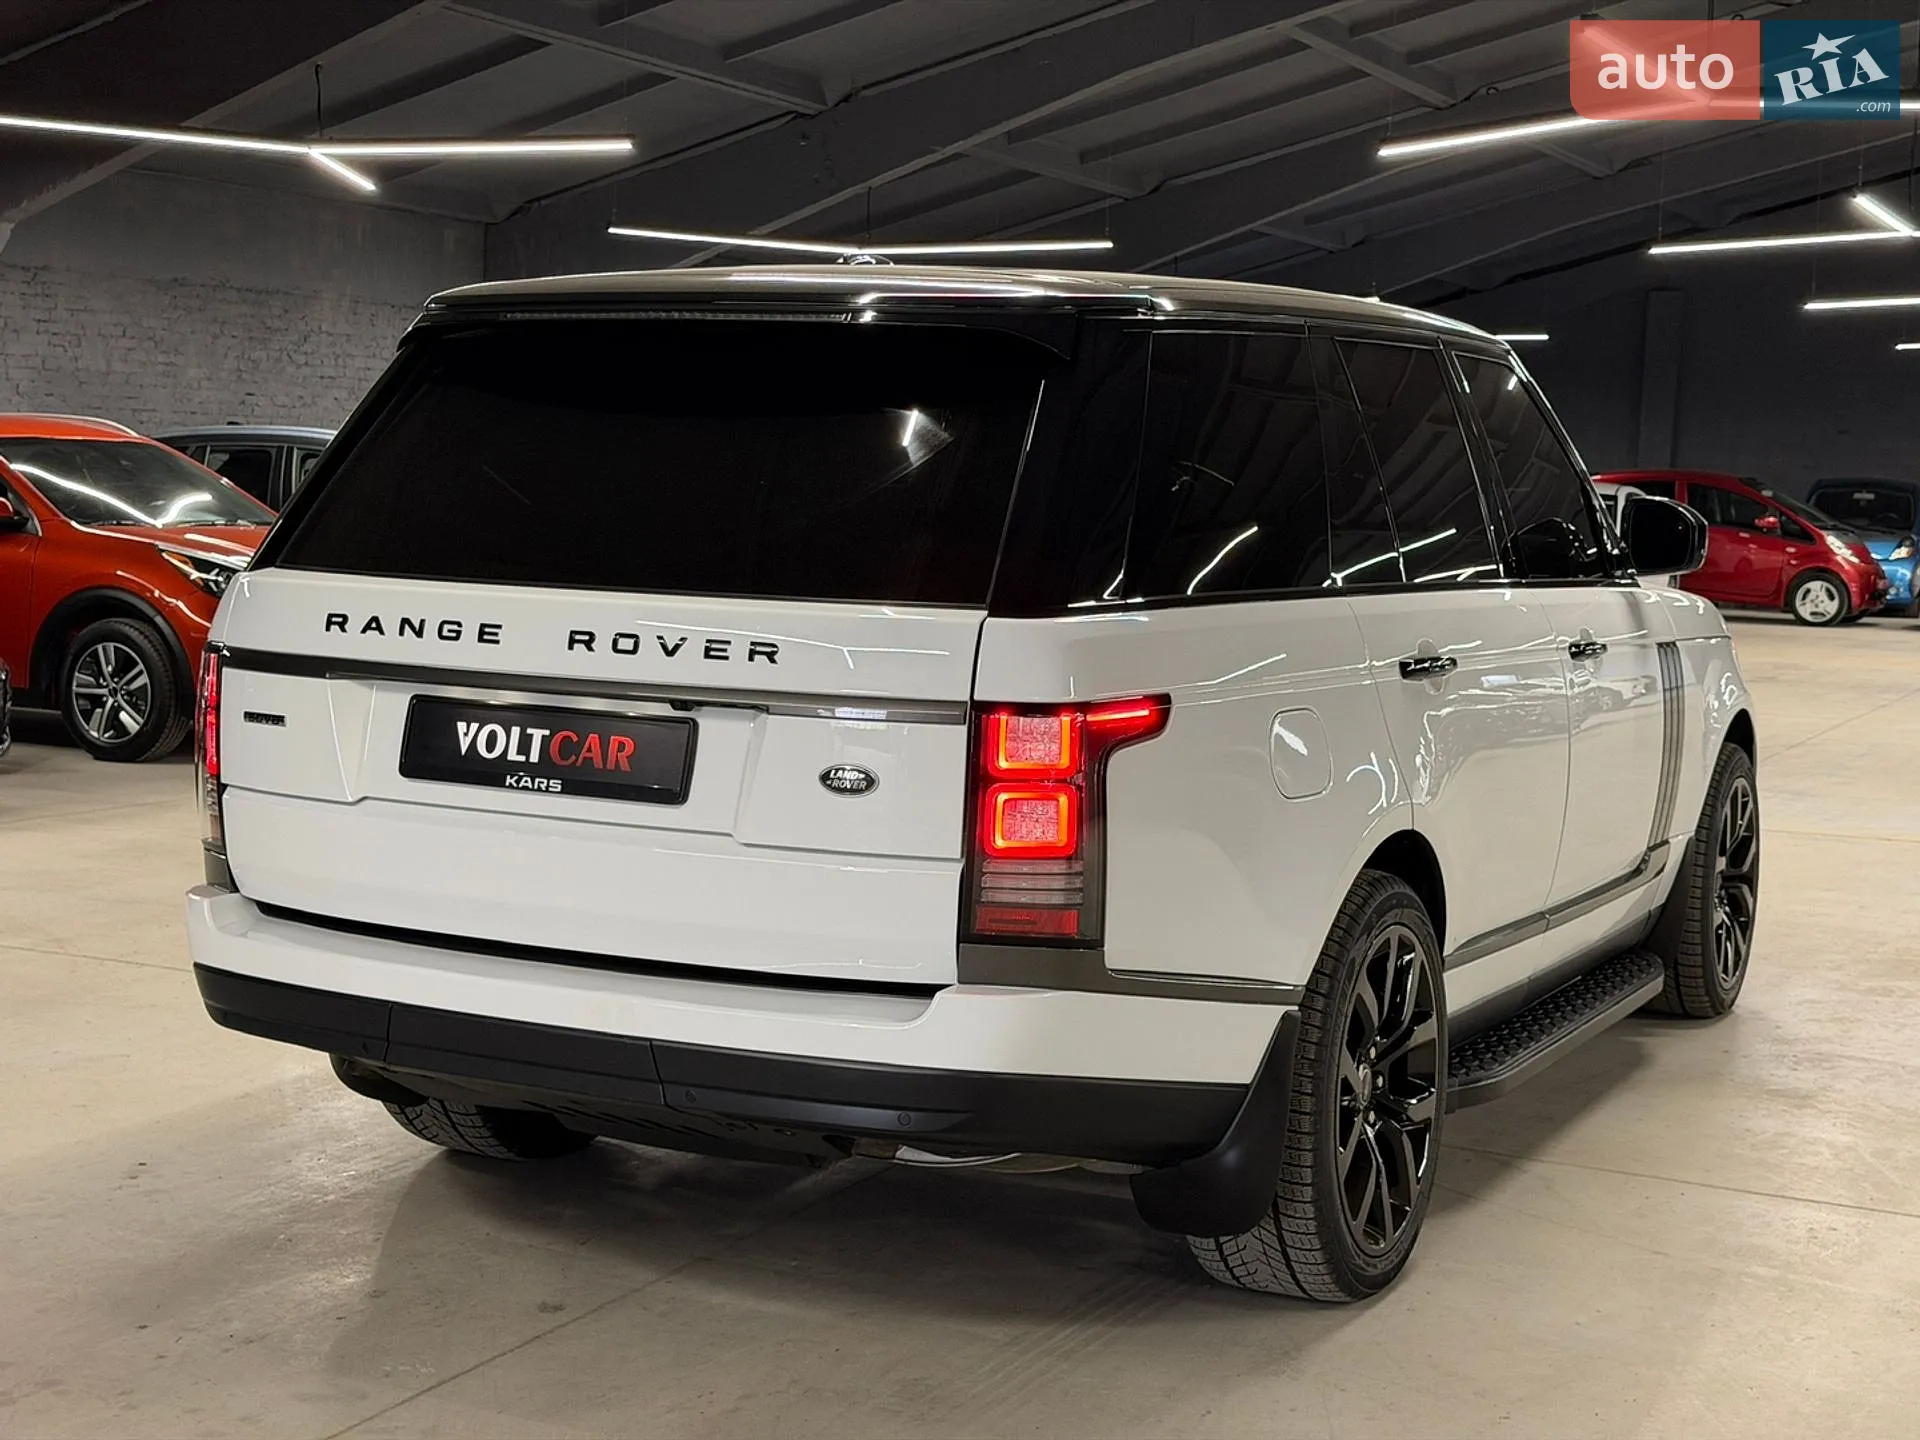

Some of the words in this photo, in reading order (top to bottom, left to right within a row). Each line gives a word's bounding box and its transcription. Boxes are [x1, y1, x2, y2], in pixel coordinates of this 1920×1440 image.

[325, 612, 503, 645] RANGE
[567, 630, 781, 665] ROVER
[456, 720, 636, 773] VOLTCAR
[505, 774, 563, 793] KARS
